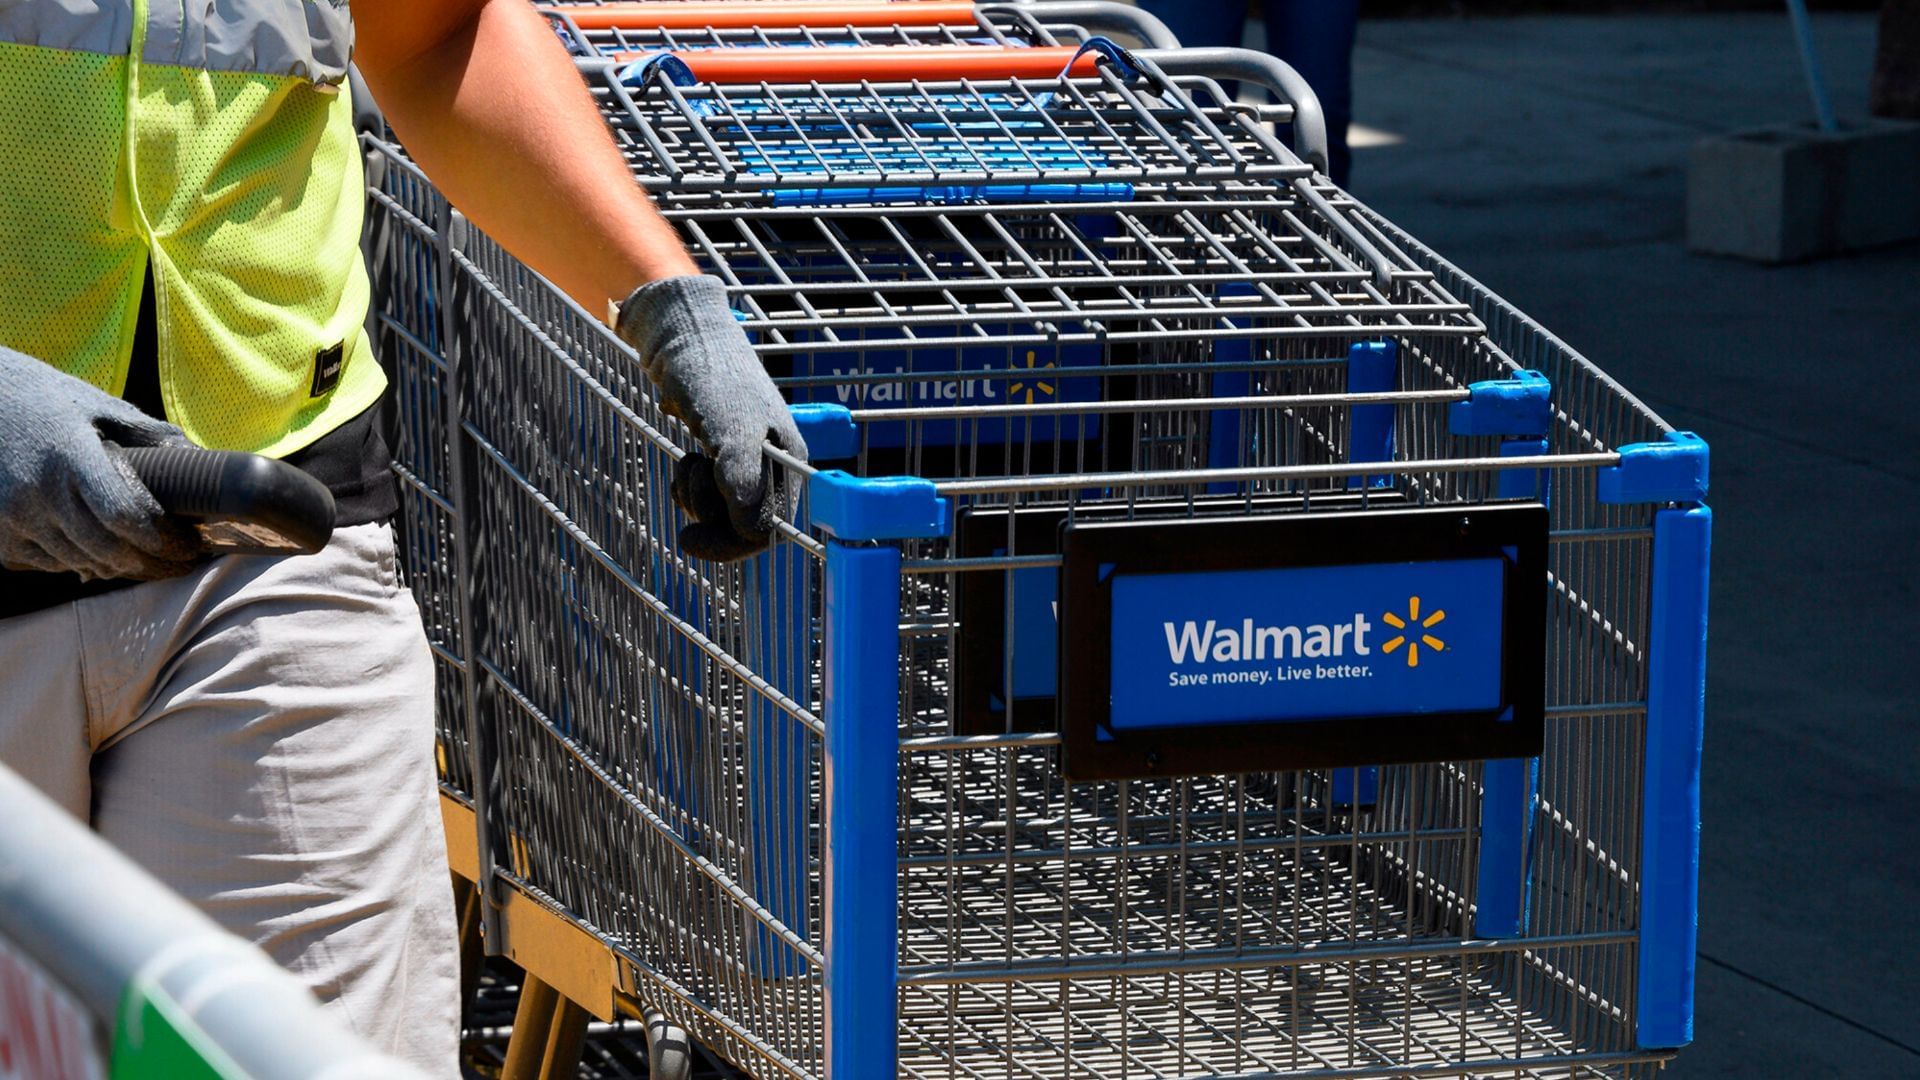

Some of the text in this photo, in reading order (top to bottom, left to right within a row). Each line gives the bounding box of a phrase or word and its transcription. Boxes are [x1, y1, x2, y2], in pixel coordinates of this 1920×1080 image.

[1164, 613, 1371, 664] Walmart
[1169, 664, 1373, 687] Save money. Live better.
